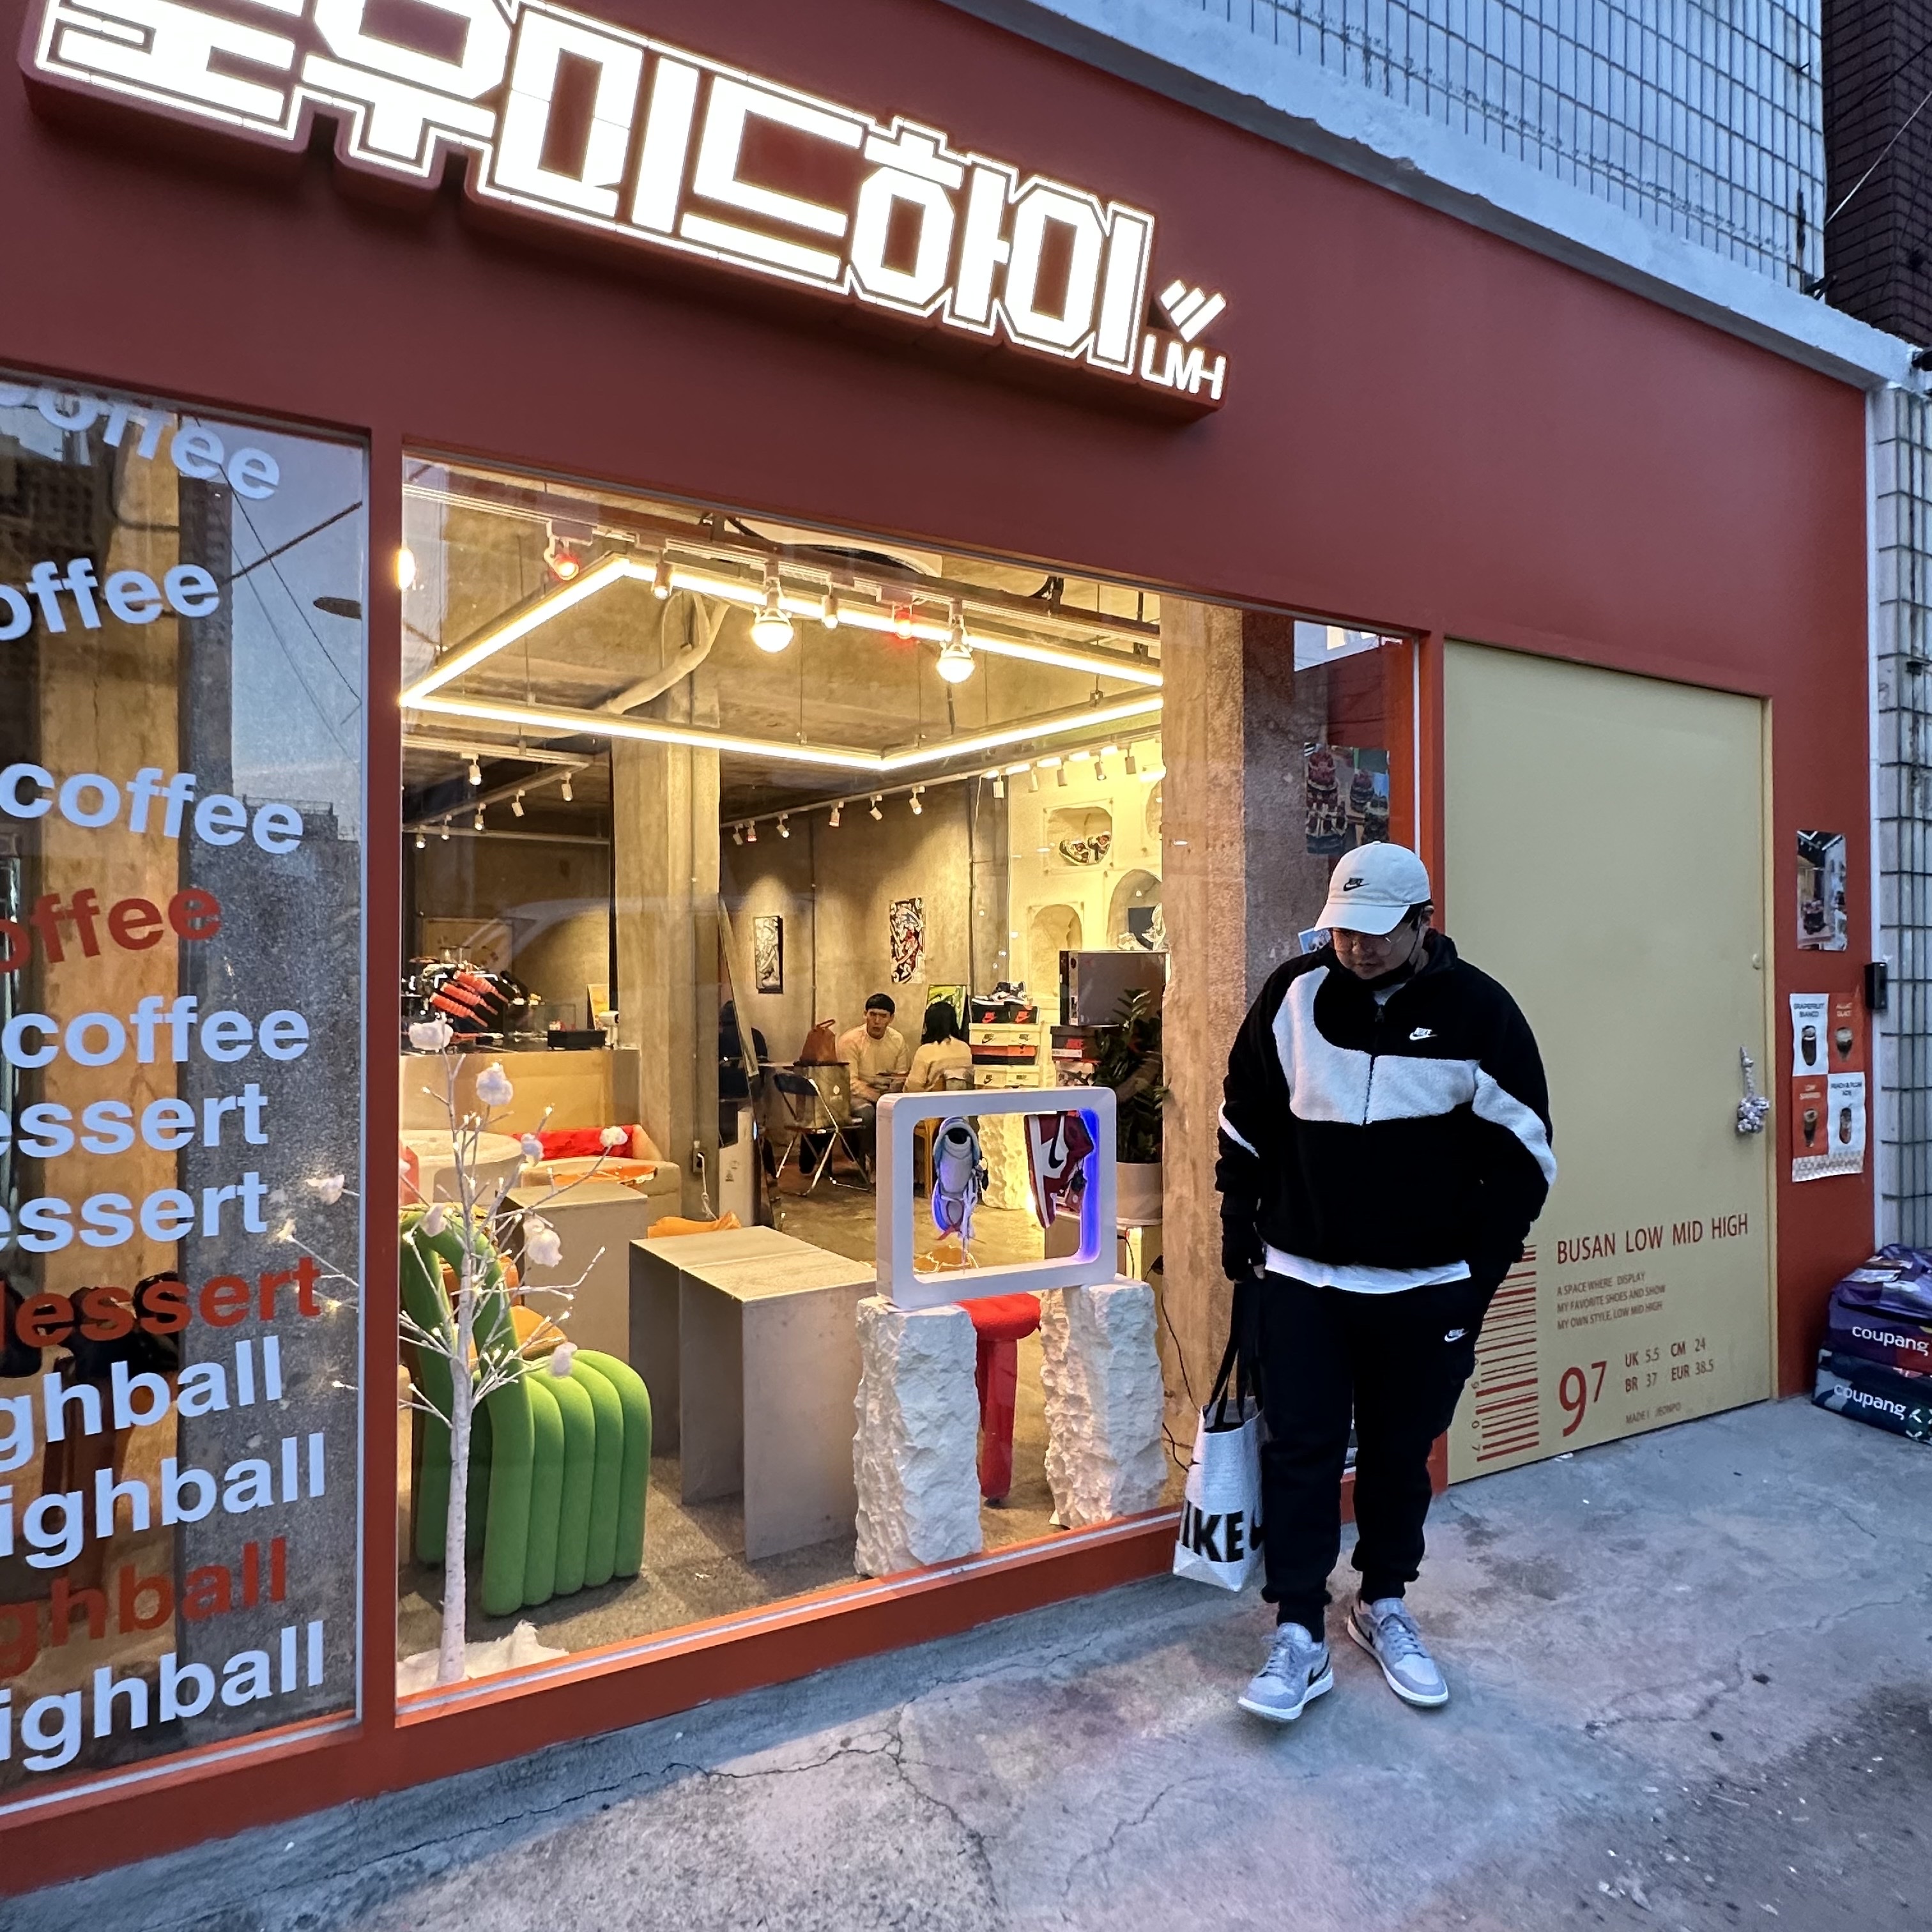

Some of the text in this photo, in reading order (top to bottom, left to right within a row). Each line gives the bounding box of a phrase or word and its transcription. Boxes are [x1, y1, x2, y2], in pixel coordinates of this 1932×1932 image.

[1140, 333, 1227, 401] LMH
[0, 763, 303, 854] coffee
[1, 995, 310, 1068] coffee
[0, 1084, 268, 1158] ssert
[0, 1172, 268, 1252] ssert
[1556, 1213, 1749, 1264] BUSAN LOW MID HIGH
[0, 1256, 319, 1347] essert
[1557, 1271, 1646, 1296] A SPACE WHERE DISPLAY
[1557, 1285, 1666, 1314] MY FAVORITE SHOES AND SHOW
[1557, 1319, 1568, 1330] MY
[1570, 1317, 1588, 1328] OWN
[1613, 1308, 1630, 1319] LOW
[1630, 1304, 1644, 1315] MID
[1645, 1301, 1663, 1314] HIGH
[1852, 1326, 1929, 1356] coupang
[1625, 1351, 1639, 1367] UK
[1670, 1340, 1686, 1357] CM
[1694, 1337, 1706, 1352] 24
[1558, 1360, 1607, 1438] 97
[1625, 1376, 1638, 1393] BR
[1646, 1372, 1657, 1388] 37
[1671, 1364, 1690, 1381] EUR
[1834, 1384, 1906, 1420] coupang
[1625, 1409, 1646, 1424] MADE
[1177, 1500, 1244, 1563] IKE
